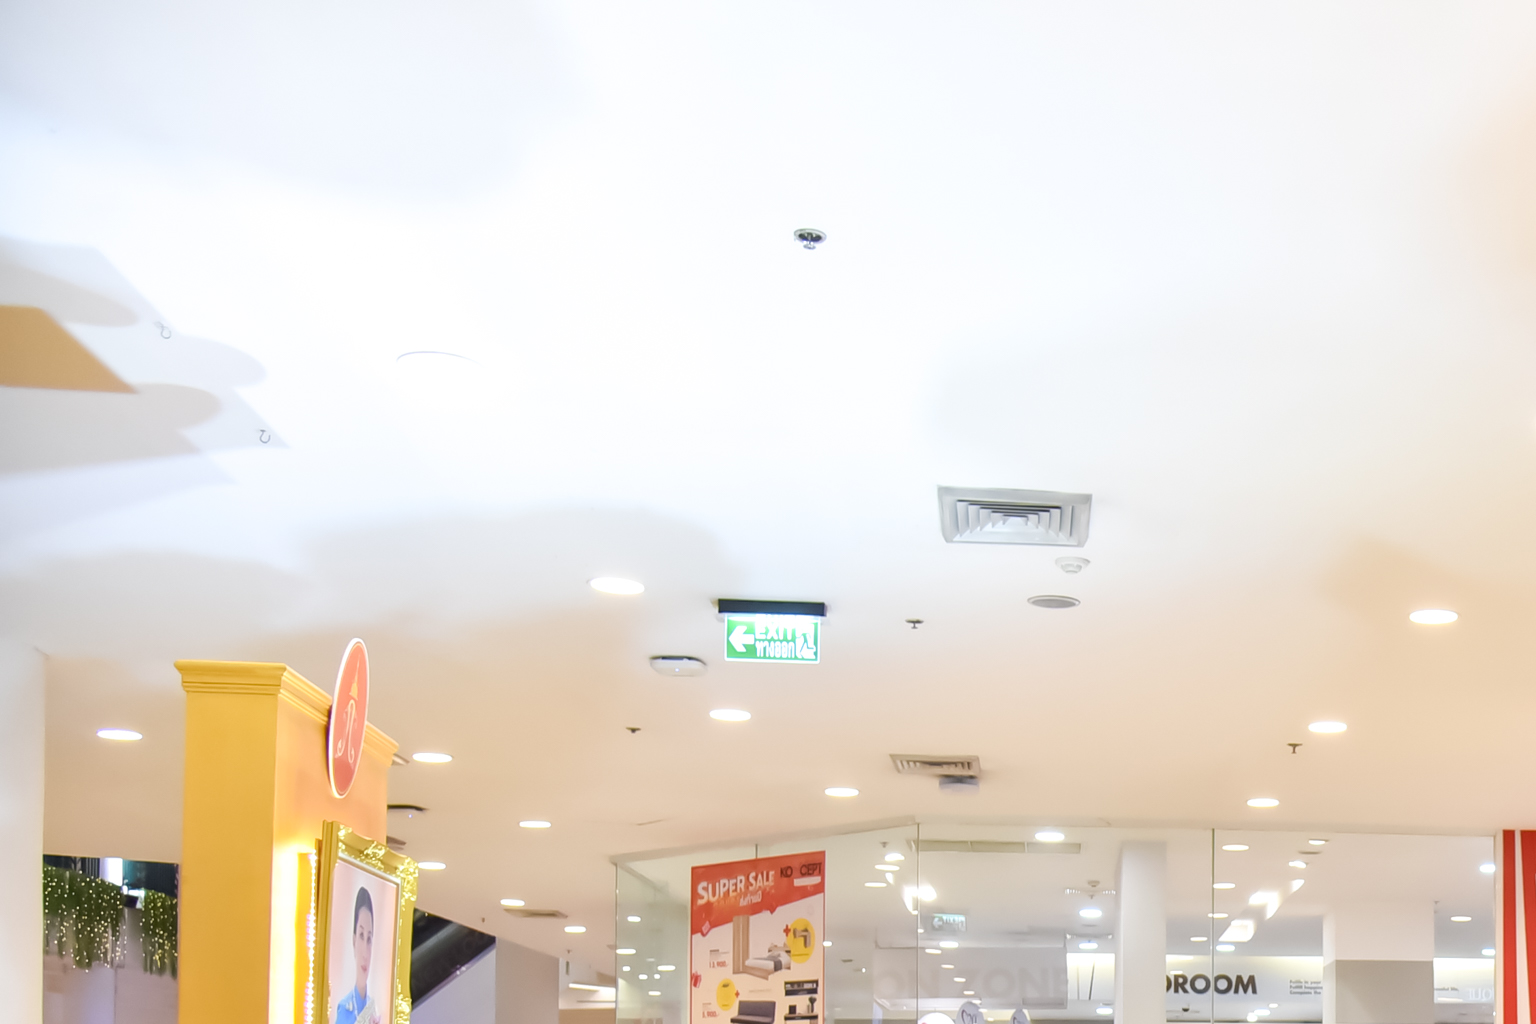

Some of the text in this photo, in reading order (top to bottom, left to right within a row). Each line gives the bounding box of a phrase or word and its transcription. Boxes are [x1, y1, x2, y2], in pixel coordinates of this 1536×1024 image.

[755, 621, 795, 640] EXIT
[755, 641, 795, 658] ทางออก
[697, 870, 775, 906] SUPER SALE
